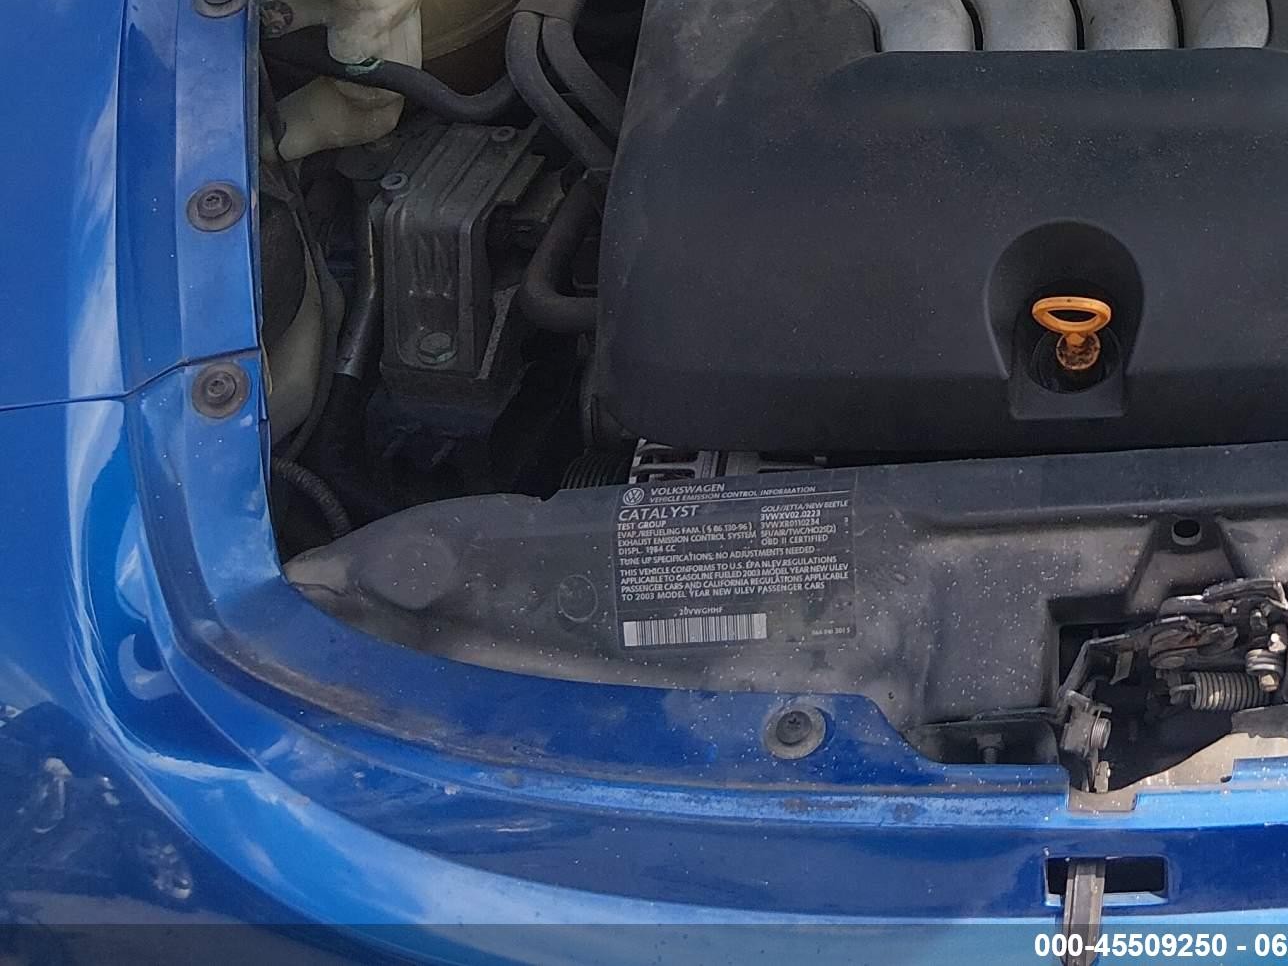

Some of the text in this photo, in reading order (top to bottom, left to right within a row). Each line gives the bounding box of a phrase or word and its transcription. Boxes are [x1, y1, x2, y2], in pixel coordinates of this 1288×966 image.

[650, 483, 725, 496] VOLKSWAGEN
[650, 486, 816, 503] VEHICLE EMISSION CONTROL INFORMATION
[823, 499, 849, 509] BEETLE
[618, 505, 700, 521] CATALYST
[617, 520, 667, 531] TEST GROUP
[617, 531, 757, 547] EXHAUST EMISSION CONTROL SYSTEM
[761, 537, 779, 546] OBD
[789, 534, 829, 544] CERTIFIED
[618, 547, 642, 556] DISPL.
[665, 544, 676, 552] CC
[620, 557, 640, 566] TUNE
[641, 556, 652, 564] UP
[715, 551, 728, 560] NO
[729, 547, 784, 559] ADJUSTMENTS
[785, 545, 815, 555] NEEDED
[620, 568, 637, 577] THIS
[639, 566, 670, 576] VEHICLE
[671, 563, 715, 573] CONFORMS
[717, 562, 728, 571] TO
[746, 560, 761, 569] EPA
[782, 556, 837, 566] REGULATIONS
[620, 563, 849, 585] APPLICABLE TO GASOLINE FUELED 2003 MODEL YEAR NEW ULEV
[621, 572, 849, 594] PASSENGER CARS AND CALIFORNIA REGULATIONS APPLICABLE
[621, 582, 825, 602] TO 2003 MODEL YEAR NEW ULEV PASSENGER CARS
